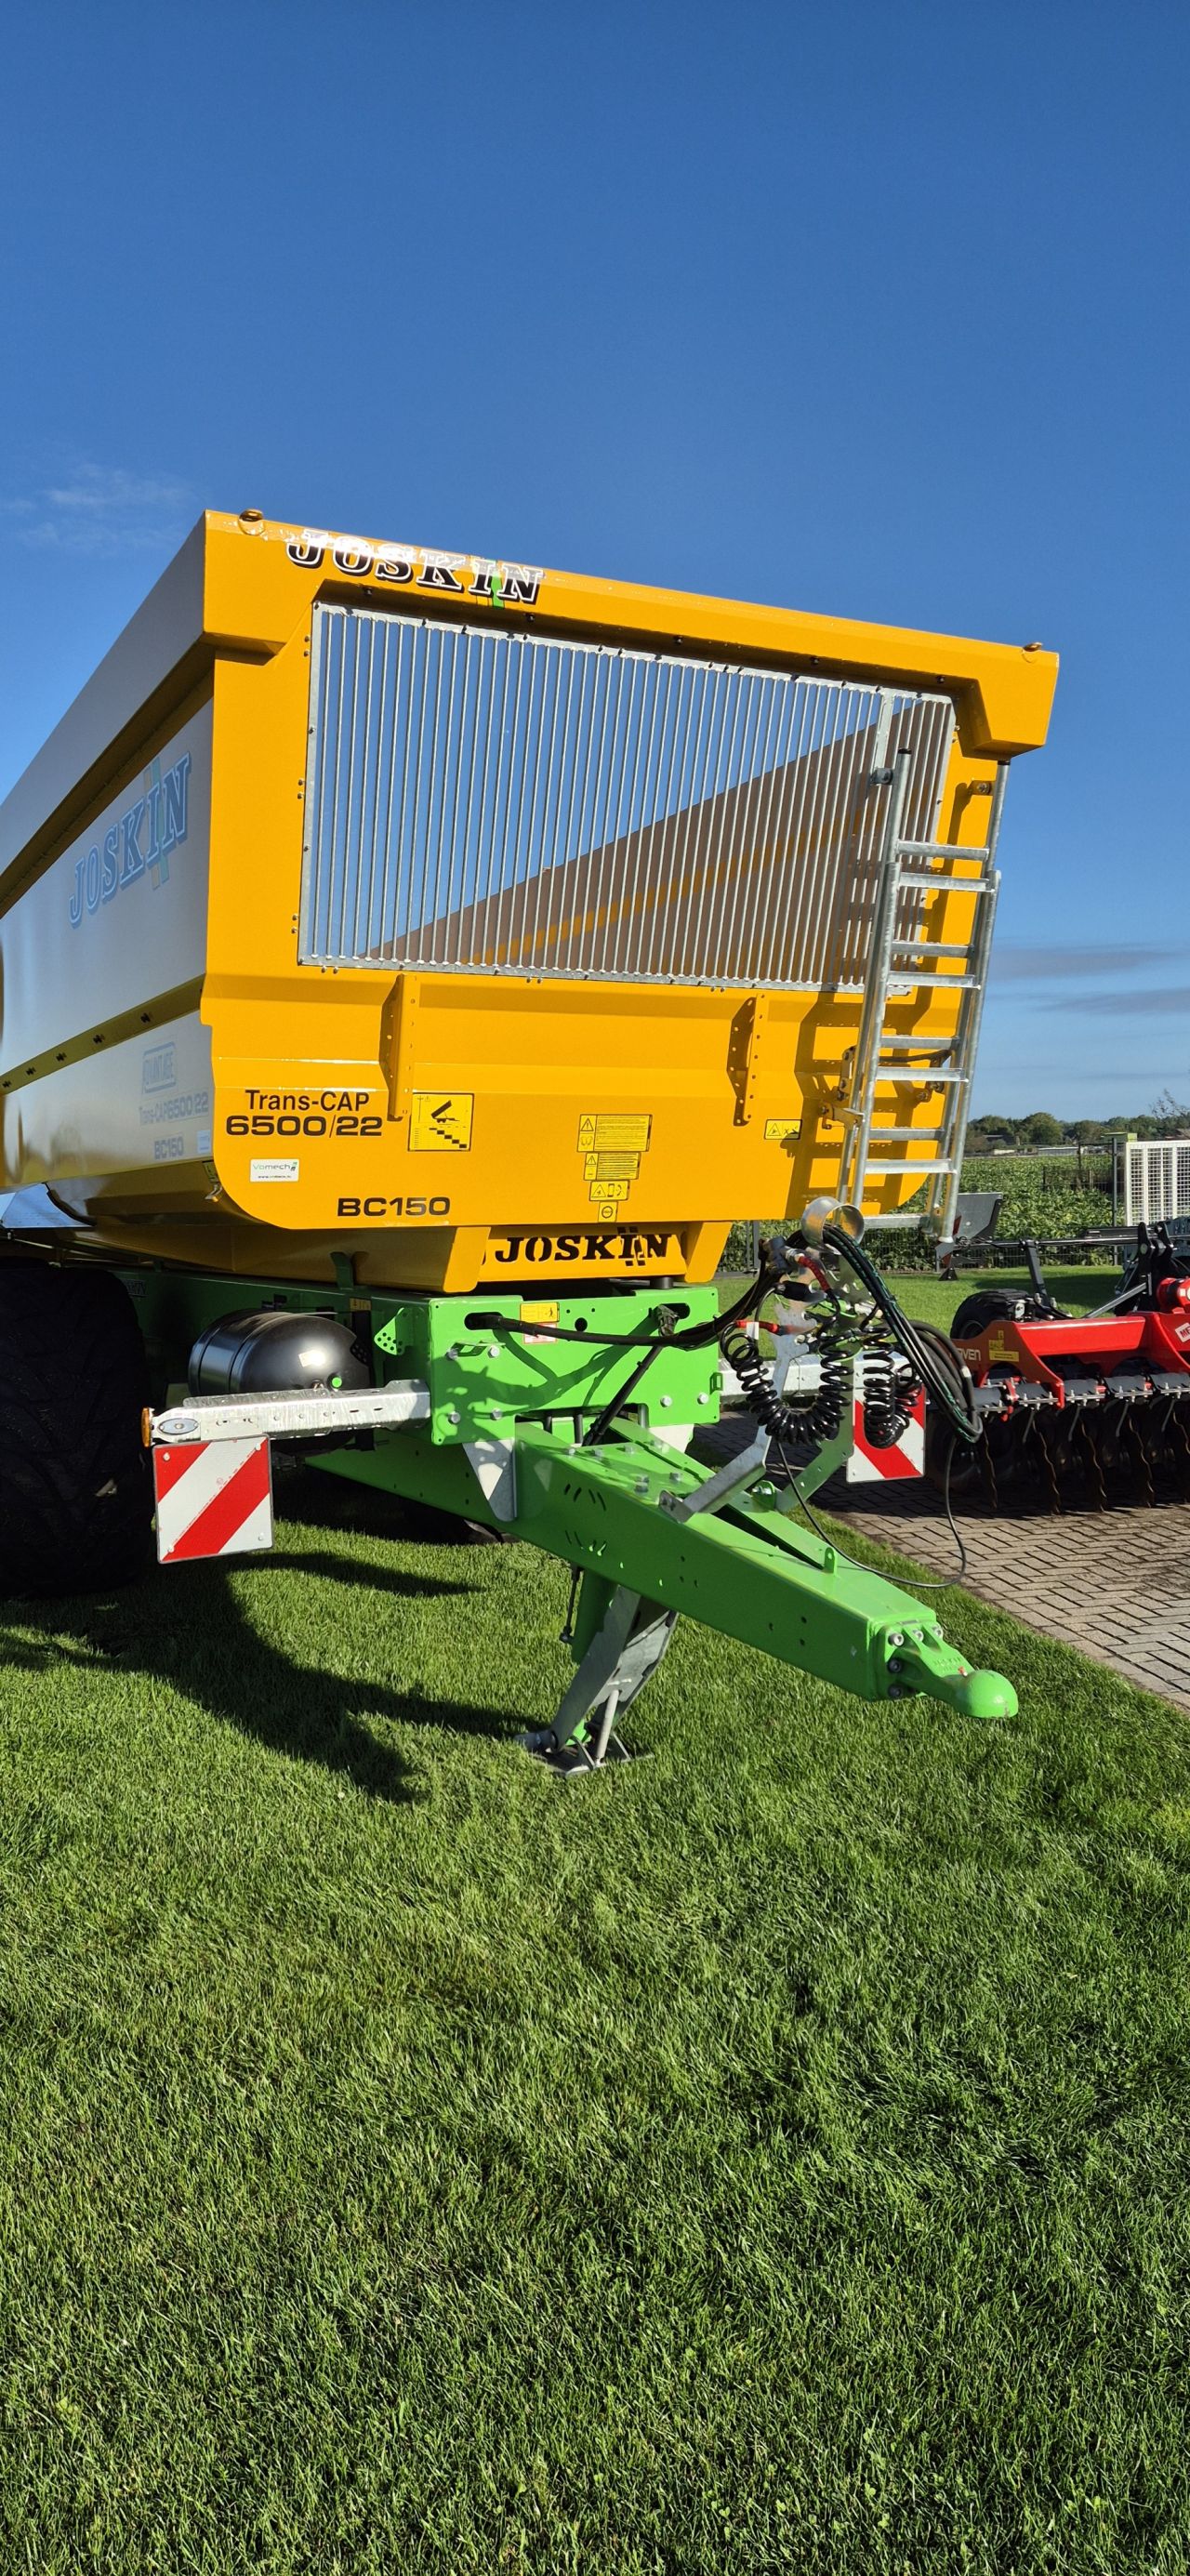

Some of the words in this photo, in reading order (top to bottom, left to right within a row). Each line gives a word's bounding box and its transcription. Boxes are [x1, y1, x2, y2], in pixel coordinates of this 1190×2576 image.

[286, 529, 546, 605] JOSKIN
[69, 752, 192, 930] JOSKIN
[245, 1090, 370, 1112] Trans-CAP
[226, 1115, 383, 1138] 6500/22
[154, 1136, 184, 1160] BC150
[337, 1197, 451, 1217] BC150
[495, 1233, 672, 1262] JOSKIN
